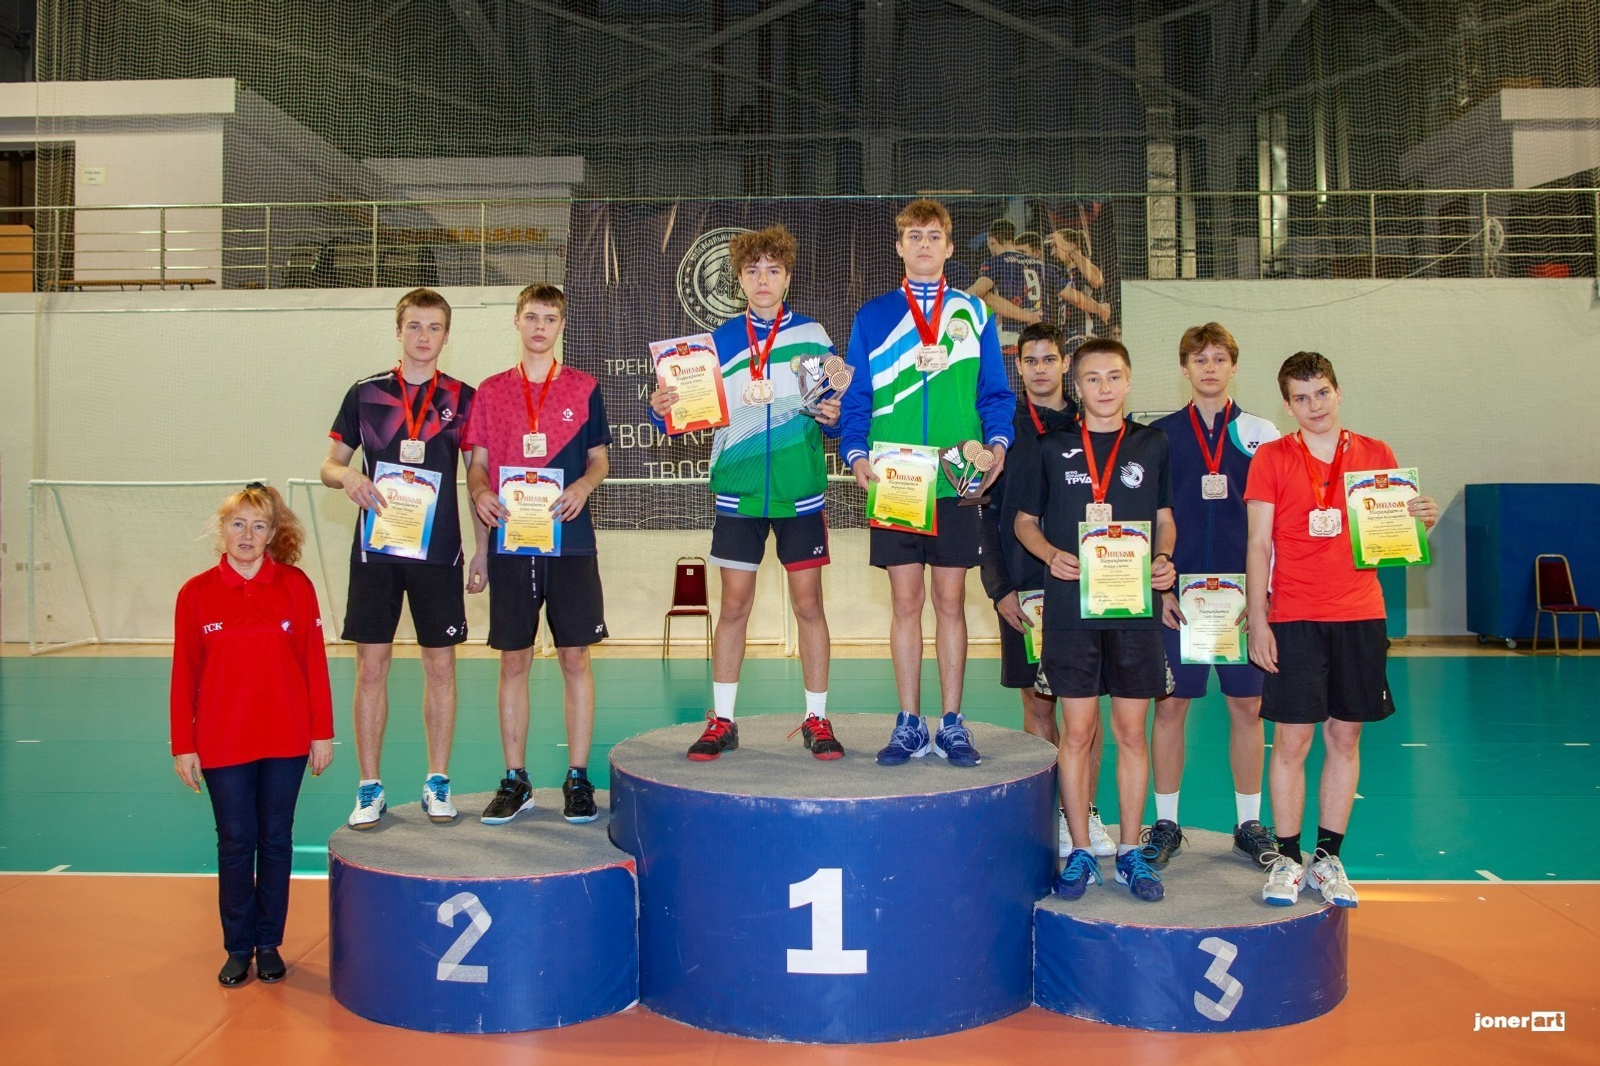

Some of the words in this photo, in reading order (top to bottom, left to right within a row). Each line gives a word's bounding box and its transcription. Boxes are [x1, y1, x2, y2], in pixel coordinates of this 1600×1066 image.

[1023, 269, 1041, 301] 9
[1067, 476, 1092, 485] ТРУД
[436, 891, 492, 984] 2
[786, 867, 868, 974] 1
[1193, 936, 1244, 1022] 3
